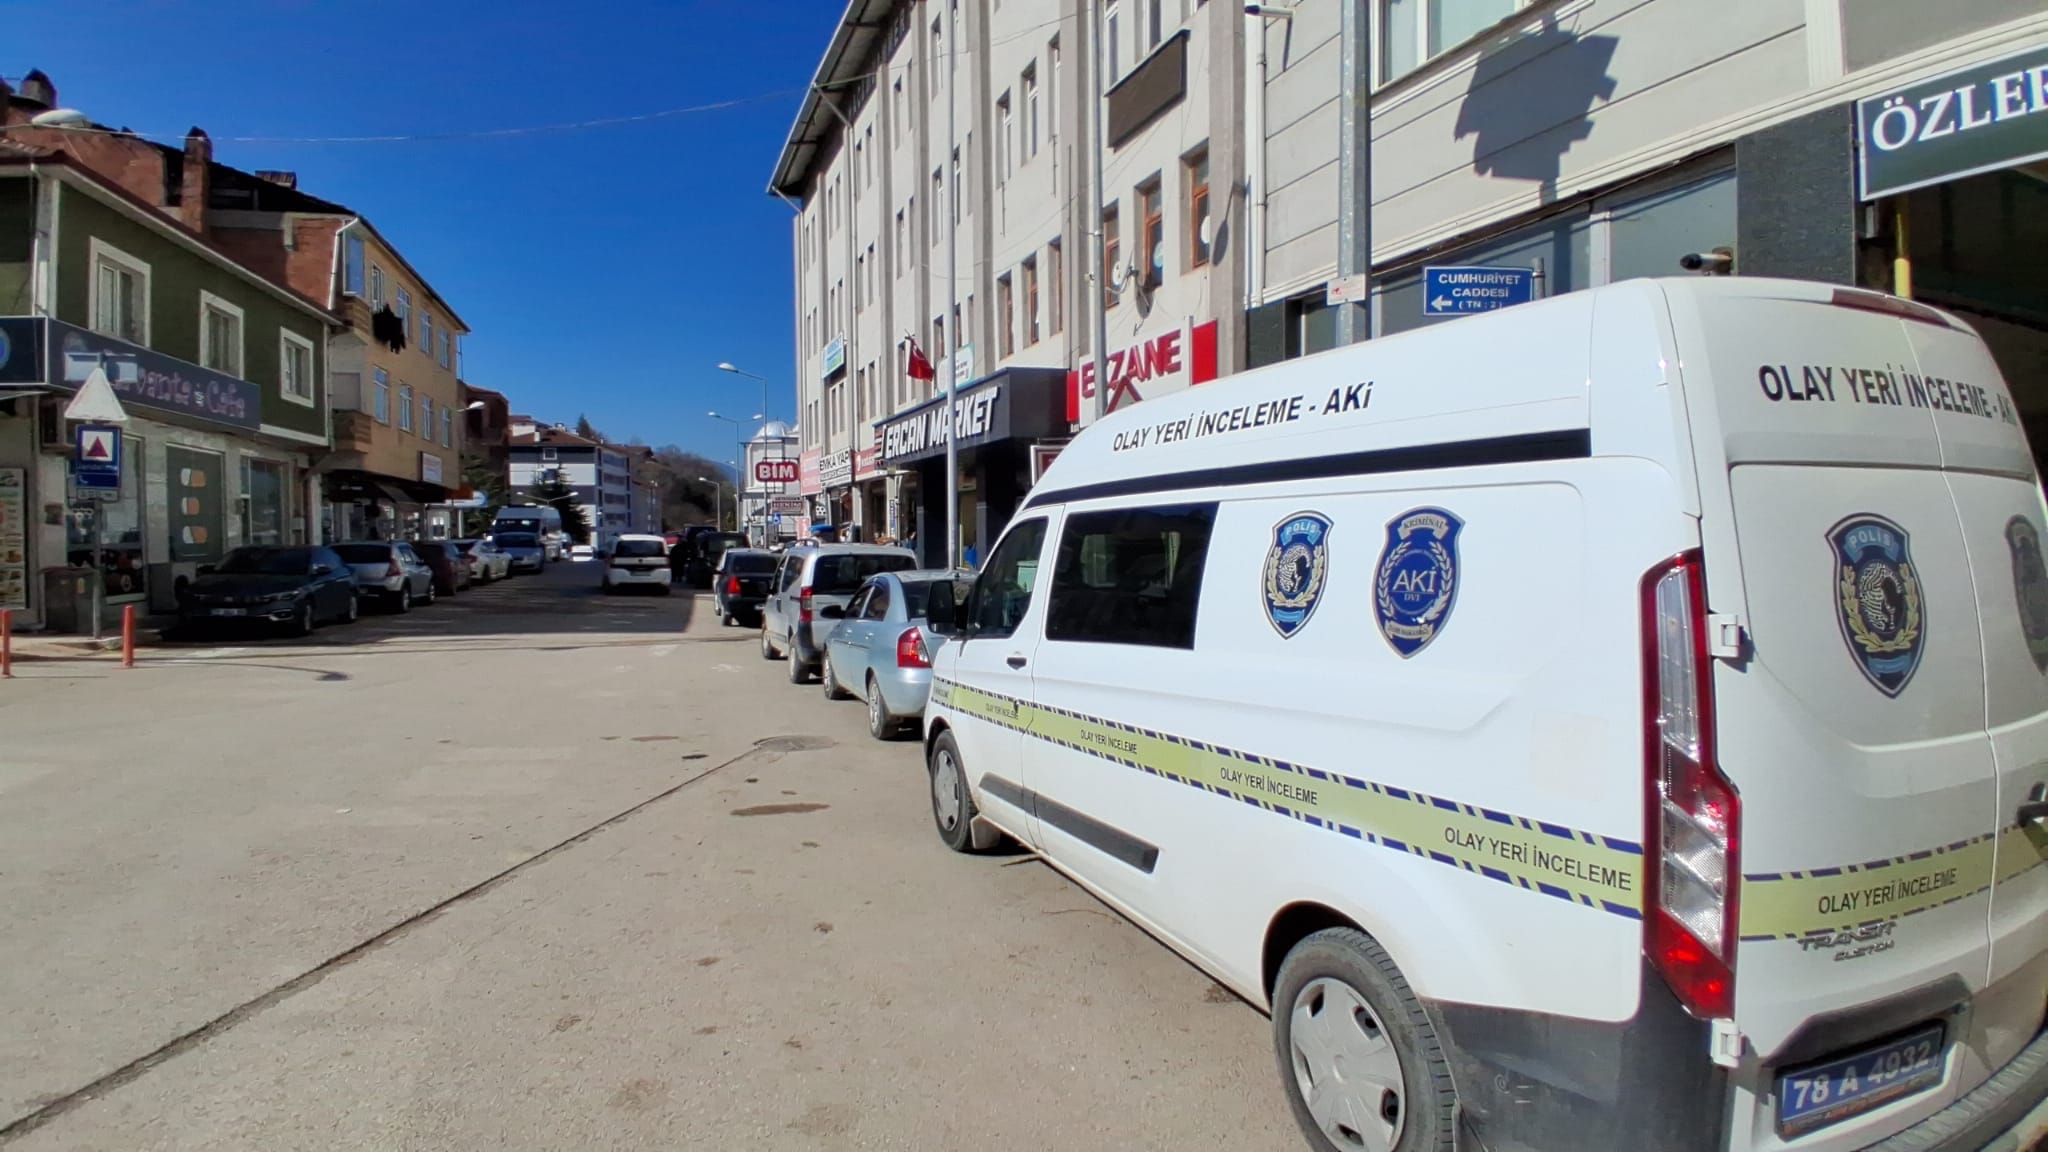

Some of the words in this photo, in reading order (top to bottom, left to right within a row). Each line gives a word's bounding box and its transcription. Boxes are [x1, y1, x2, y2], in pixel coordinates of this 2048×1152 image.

[1438, 273, 1521, 286] CUMHURİYET
[1452, 287, 1509, 298] CADDESİ
[1082, 329, 1181, 399] EZANE
[1758, 365, 1836, 402] OLAY
[1841, 363, 1902, 406] YERİ
[1900, 364, 1992, 418] İNCELEME
[885, 413, 929, 459] ERCAN
[1113, 426, 1151, 452] OLAY
[1154, 412, 1195, 445] YERİ
[1195, 395, 1304, 438] İNCELEME
[1392, 566, 1437, 593] AKİ
[1220, 767, 1243, 784] OLAY
[1244, 775, 1265, 791] YERİ
[1266, 780, 1318, 806] İNCELEME
[1444, 827, 1486, 852] OLAY
[1488, 838, 1528, 864] YERİ
[1532, 845, 1632, 892] İNCELEME
[1818, 891, 1860, 914] OLAY
[1862, 880, 1896, 907] YERİ
[1897, 868, 1957, 900] İNCELEME
[1793, 1073, 1830, 1110] 78
[1838, 1066, 1859, 1097] A
[1867, 1040, 1931, 1084] 4932
